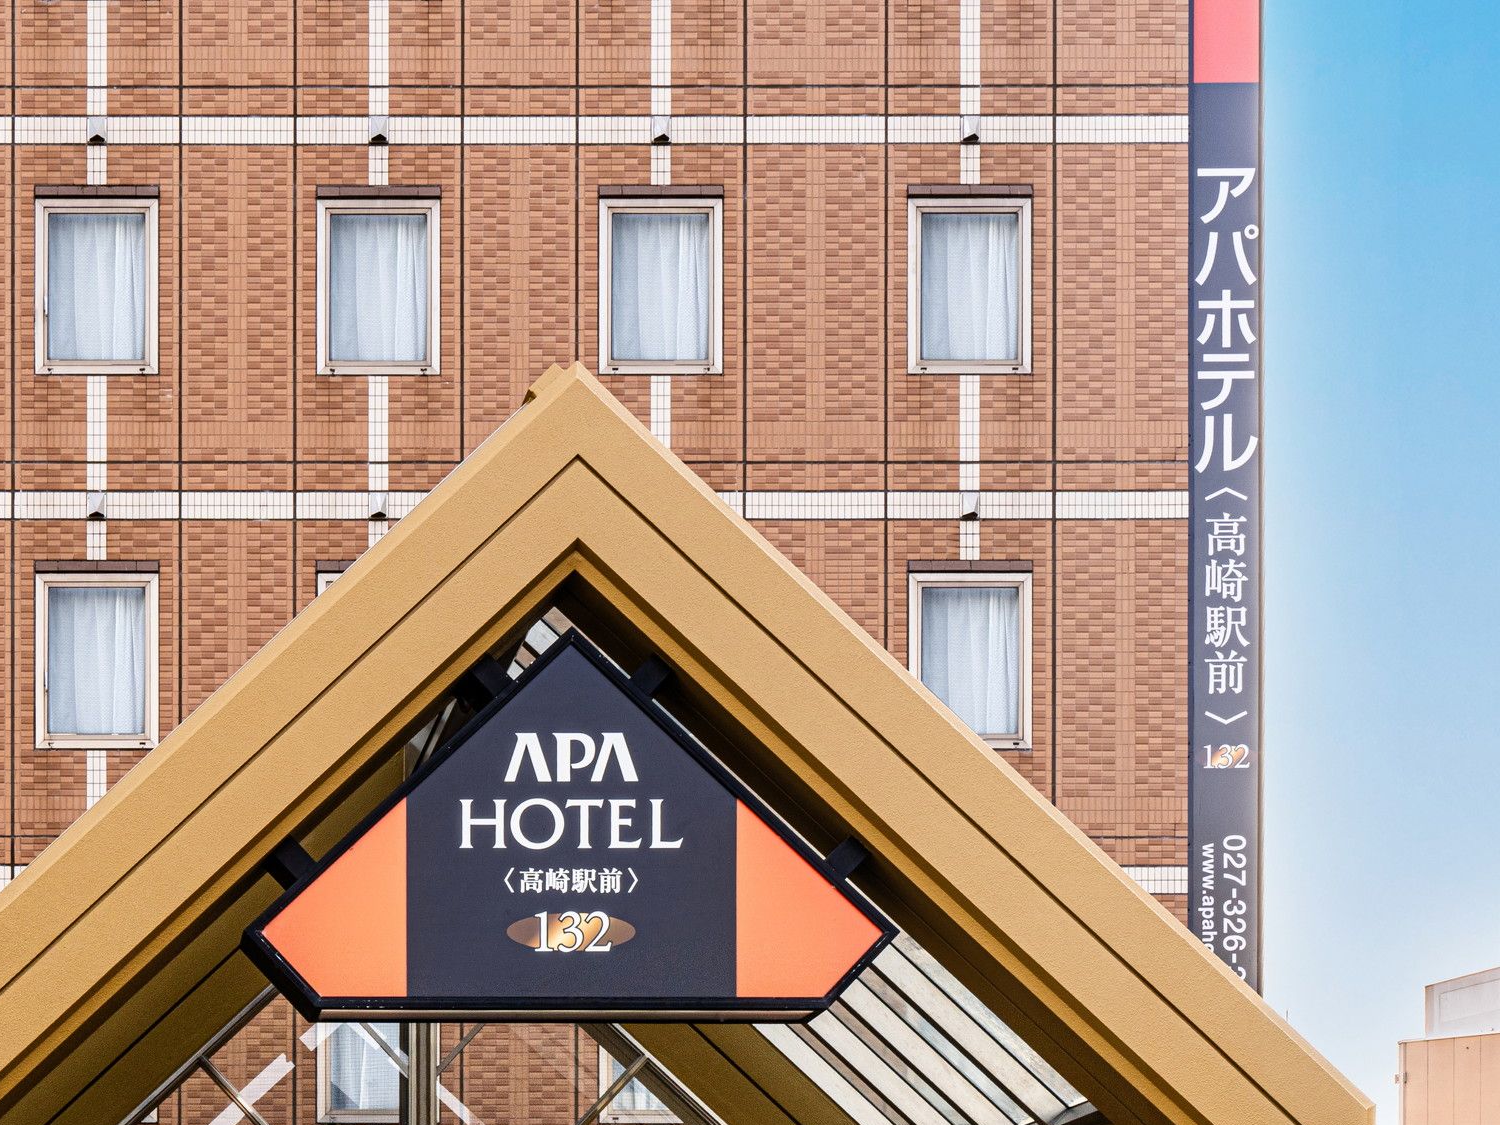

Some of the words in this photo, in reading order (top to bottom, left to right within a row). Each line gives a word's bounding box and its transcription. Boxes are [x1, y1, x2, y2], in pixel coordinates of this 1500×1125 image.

[1195, 167, 1258, 474] アパホテル
[504, 732, 639, 782] APA
[1203, 743, 1250, 769] 132
[459, 798, 684, 850] HOTEL
[534, 910, 612, 953] 132
